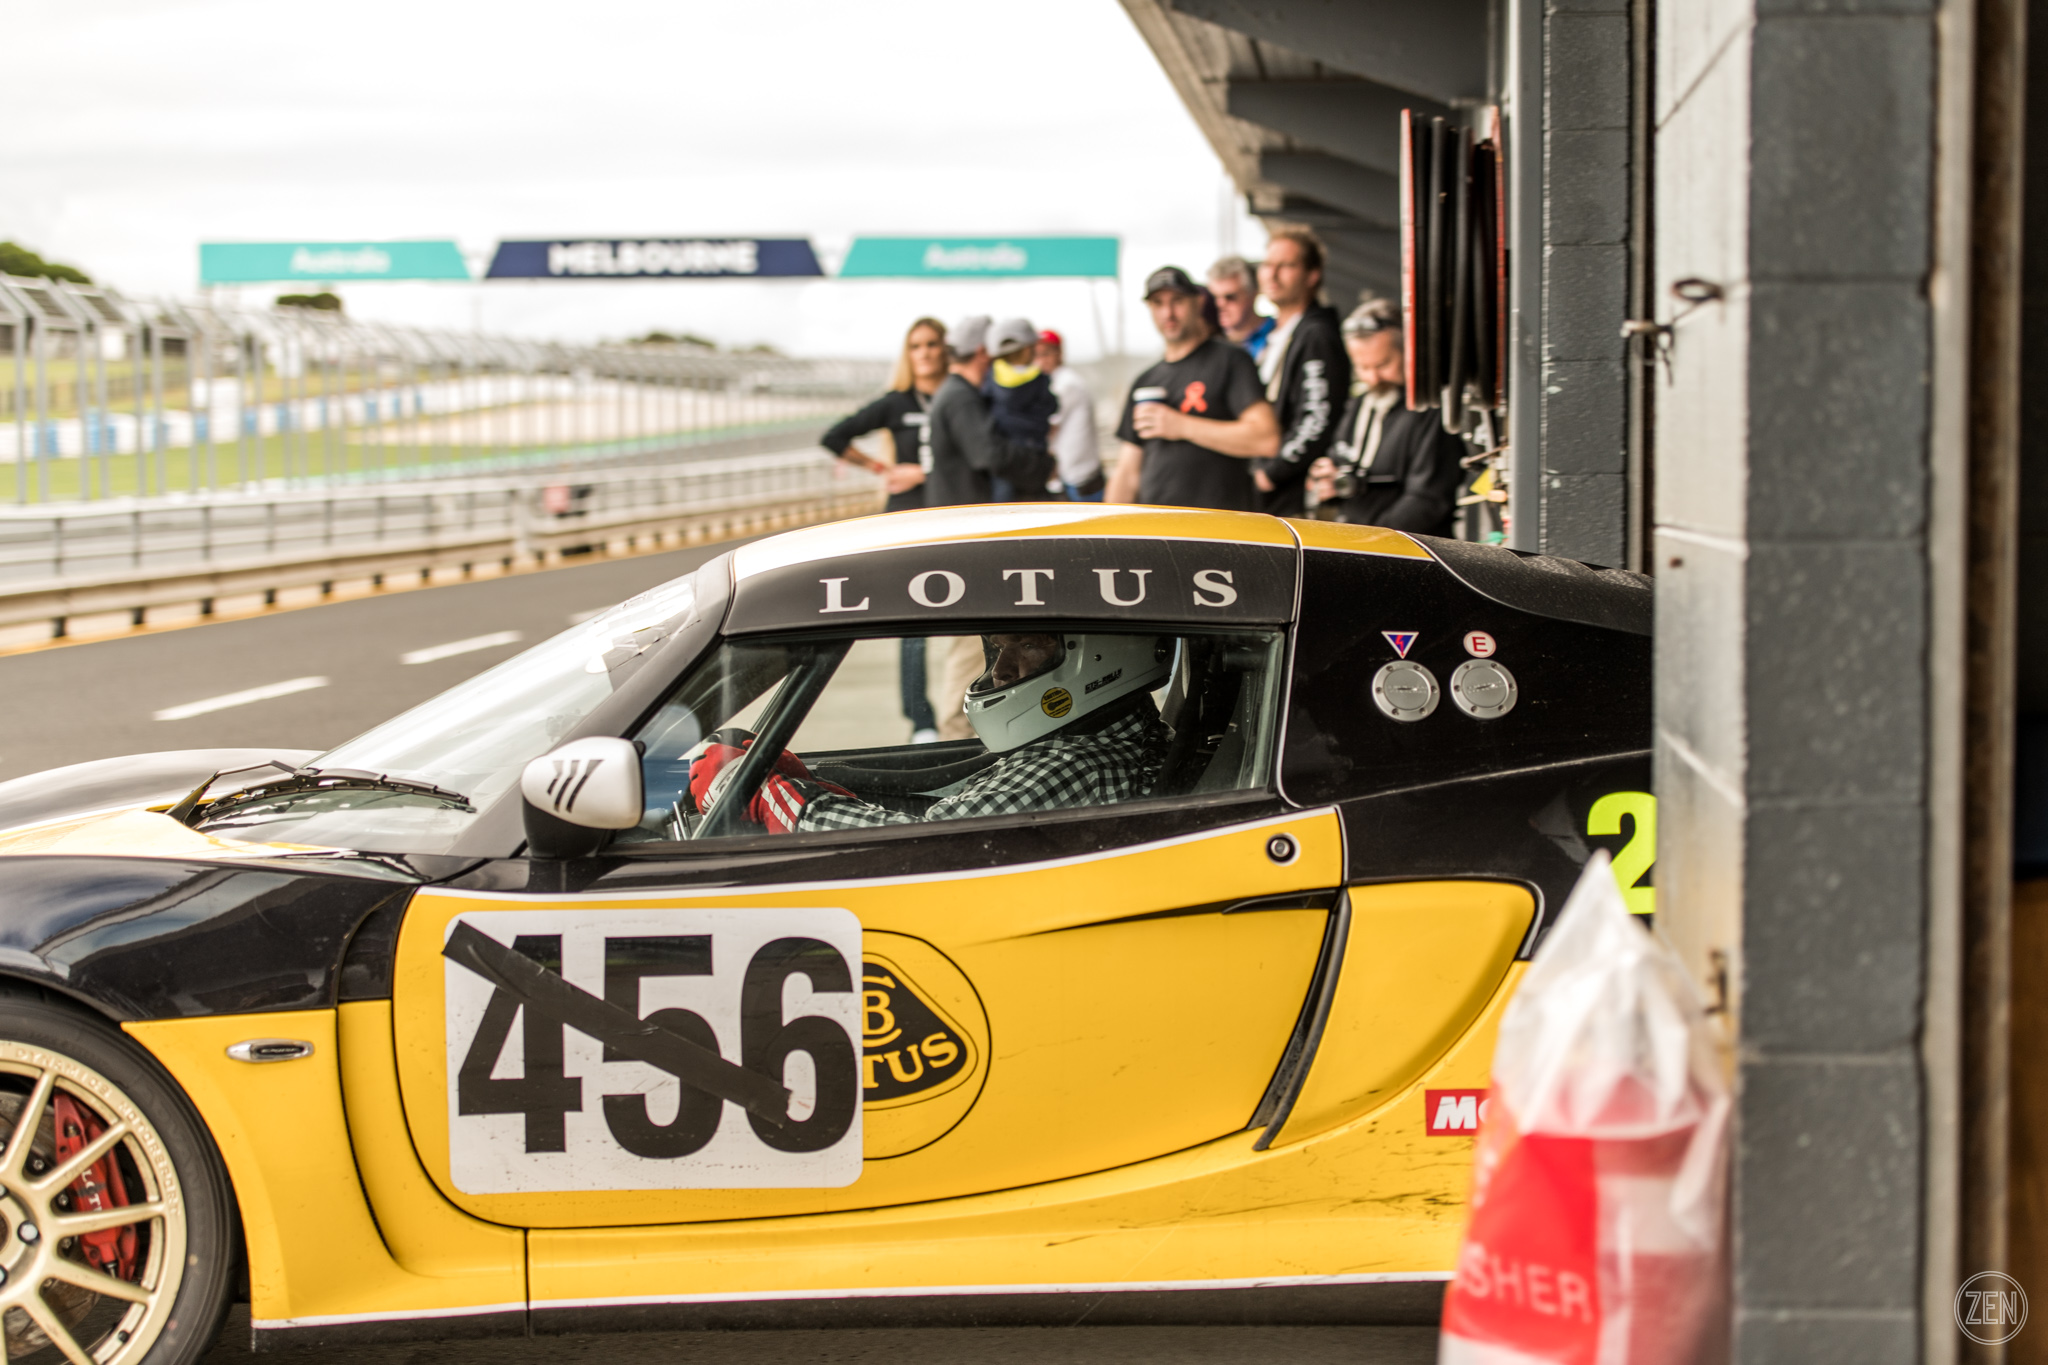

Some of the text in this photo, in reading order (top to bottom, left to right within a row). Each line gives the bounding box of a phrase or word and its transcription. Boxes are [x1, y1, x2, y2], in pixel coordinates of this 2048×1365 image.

[548, 242, 759, 274] MELBOURNE
[921, 242, 1028, 271] Australia
[819, 568, 1239, 613] LOTUS
[1471, 636, 1488, 652] E
[1587, 791, 1657, 914] 2
[458, 934, 858, 1159] 456
[862, 1031, 959, 1089] TUS
